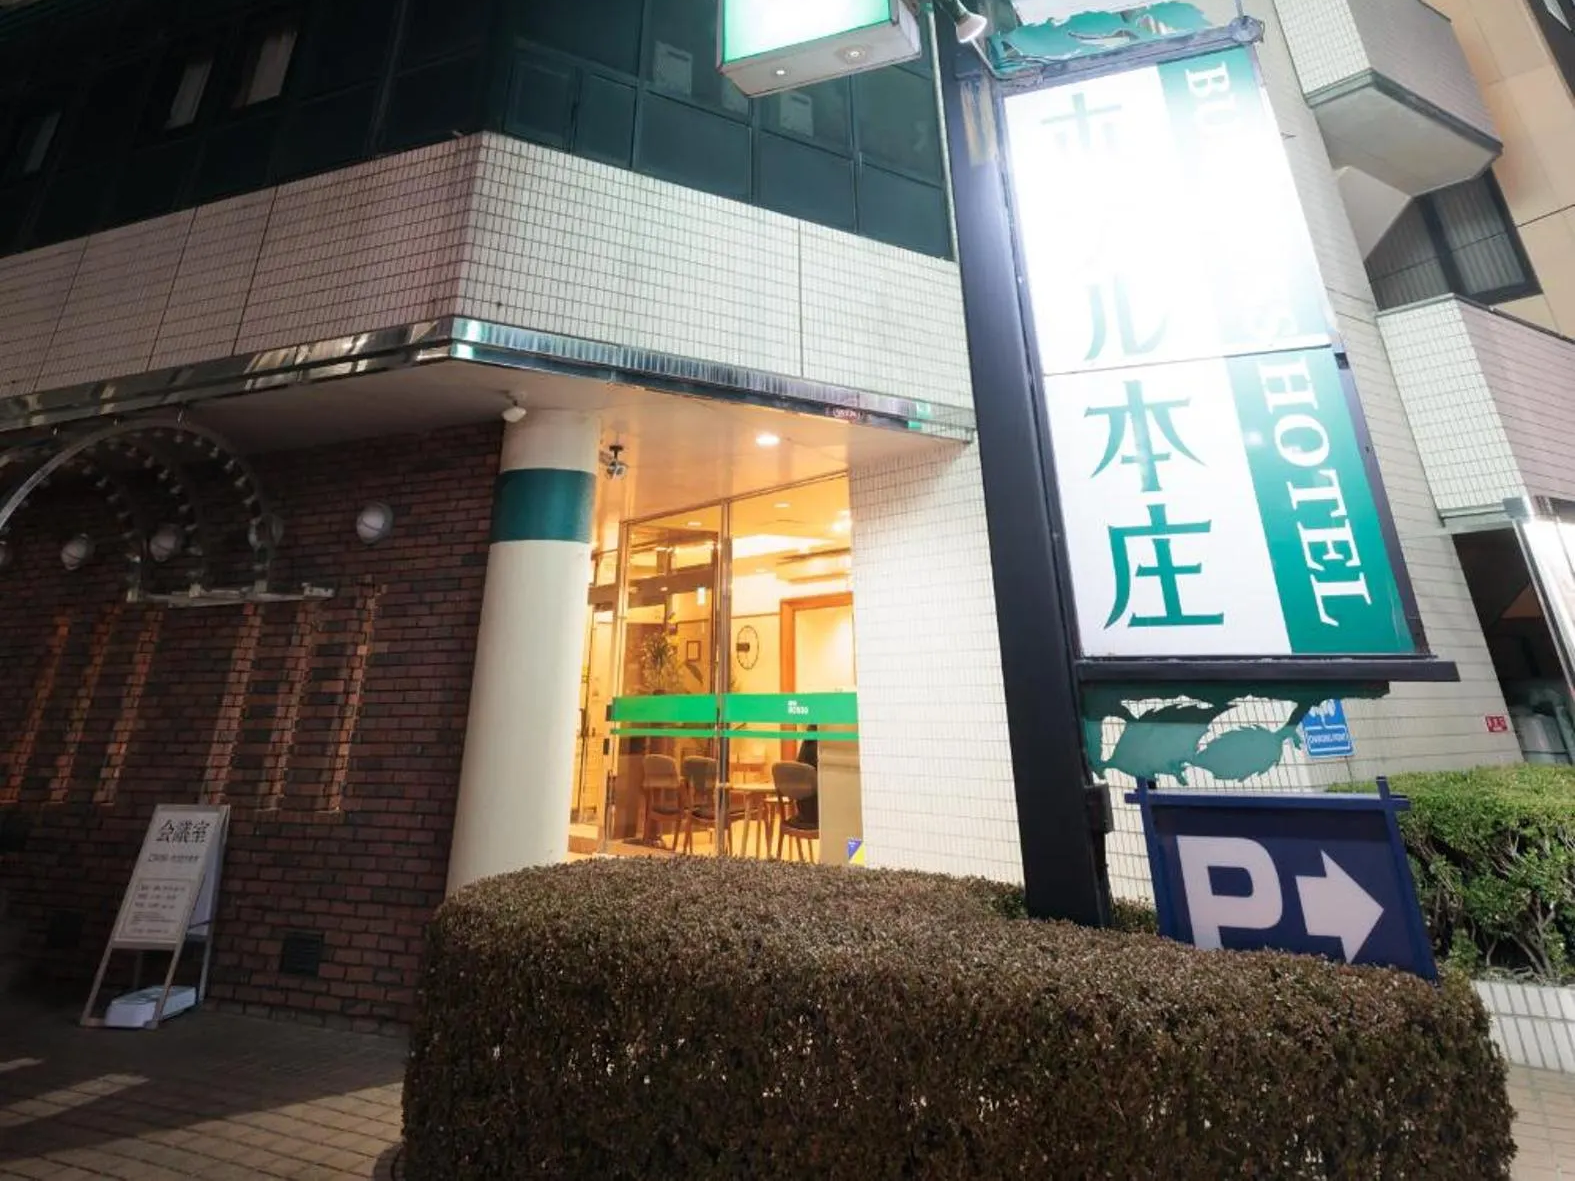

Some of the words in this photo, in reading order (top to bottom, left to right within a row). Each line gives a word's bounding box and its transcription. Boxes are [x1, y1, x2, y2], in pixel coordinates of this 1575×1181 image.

[1258, 358, 1373, 627] HOTEL
[156, 819, 210, 843] 会議室
[1176, 834, 1283, 950] P
